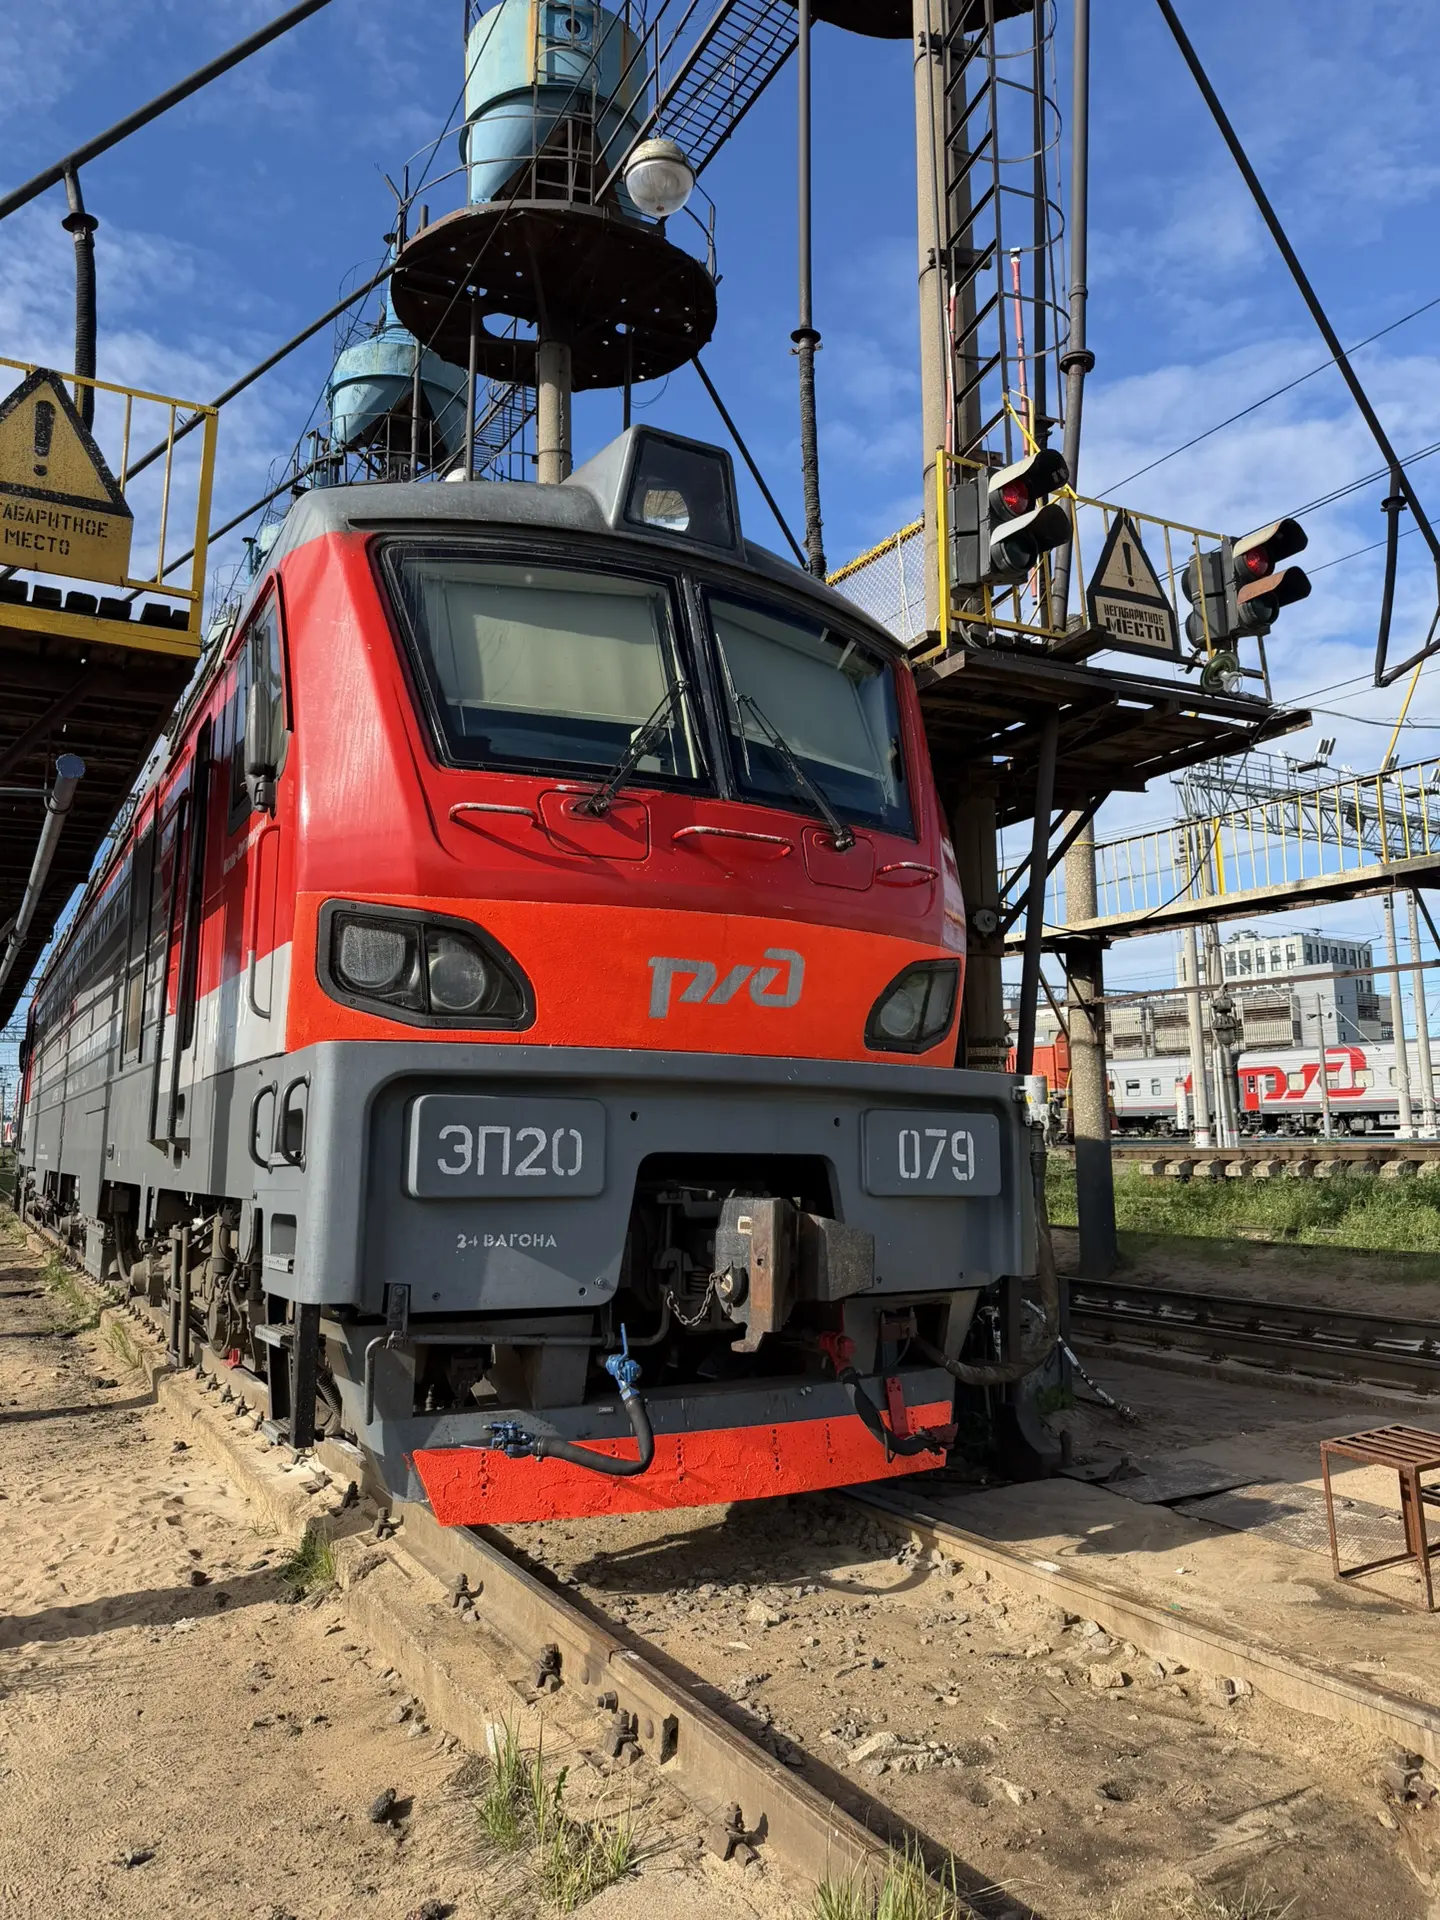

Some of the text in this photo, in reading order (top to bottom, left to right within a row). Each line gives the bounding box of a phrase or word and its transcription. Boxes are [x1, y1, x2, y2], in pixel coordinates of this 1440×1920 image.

[0, 502, 109, 538] АБАРИТНОЕ
[4, 527, 71, 556] МЕСТО
[1103, 603, 1164, 626] НЕГАБАРИТНОЕ
[1105, 616, 1167, 642] МЕСТО
[648, 947, 806, 1019] РЖД
[437, 1124, 583, 1176] ЭП20
[898, 1128, 975, 1181] 079
[482, 1233, 558, 1248] ВАГОНА
